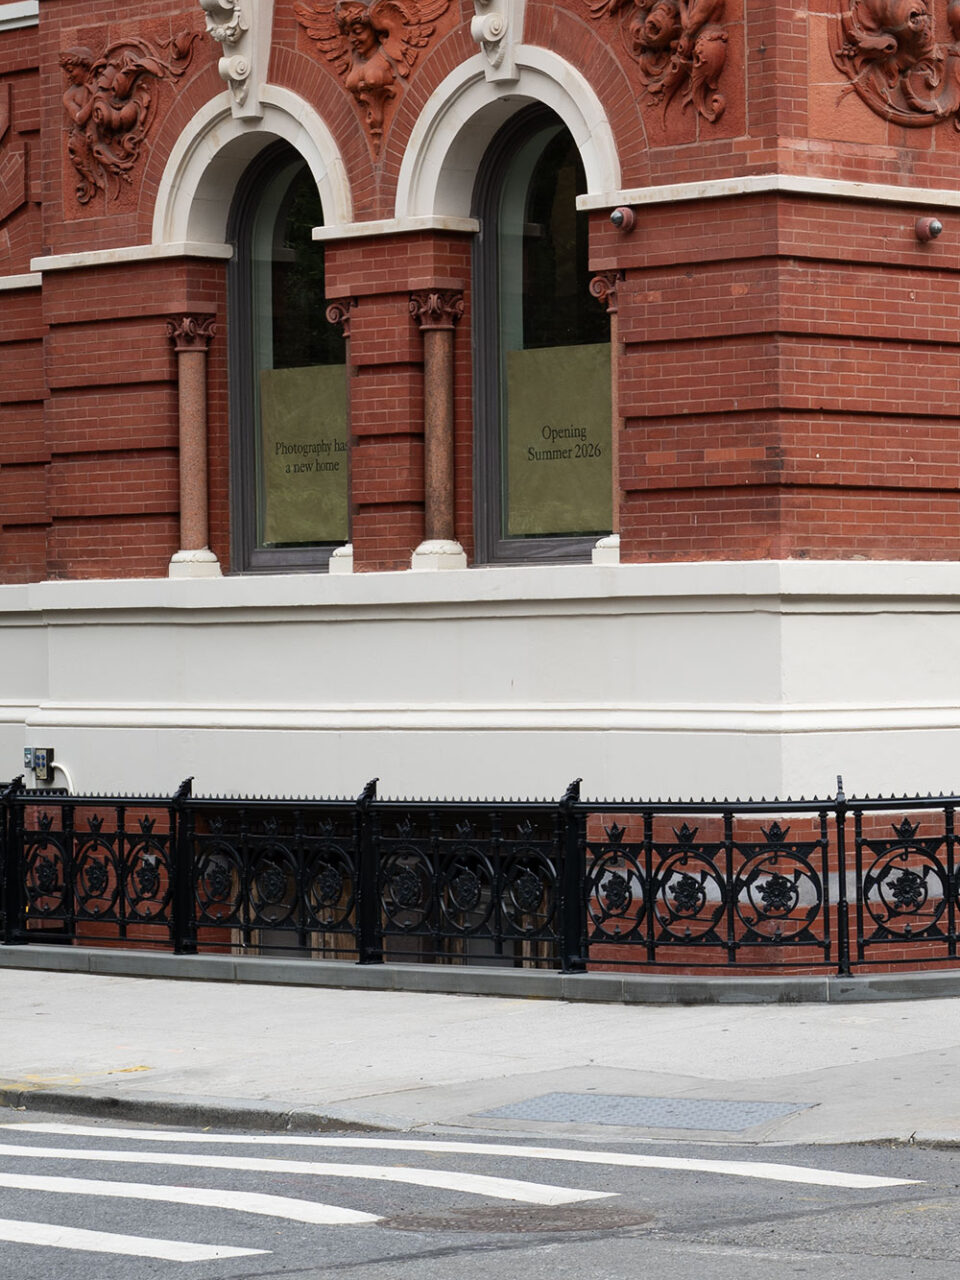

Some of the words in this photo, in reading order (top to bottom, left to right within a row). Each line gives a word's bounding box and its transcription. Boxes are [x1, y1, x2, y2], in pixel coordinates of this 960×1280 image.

[542, 424, 587, 443] Opening
[275, 439, 332, 457] Photography
[528, 446, 573, 461] Summer
[574, 443, 602, 458] 2026
[285, 463, 291, 473] a
[293, 462, 314, 473] new
[315, 458, 340, 472] home
